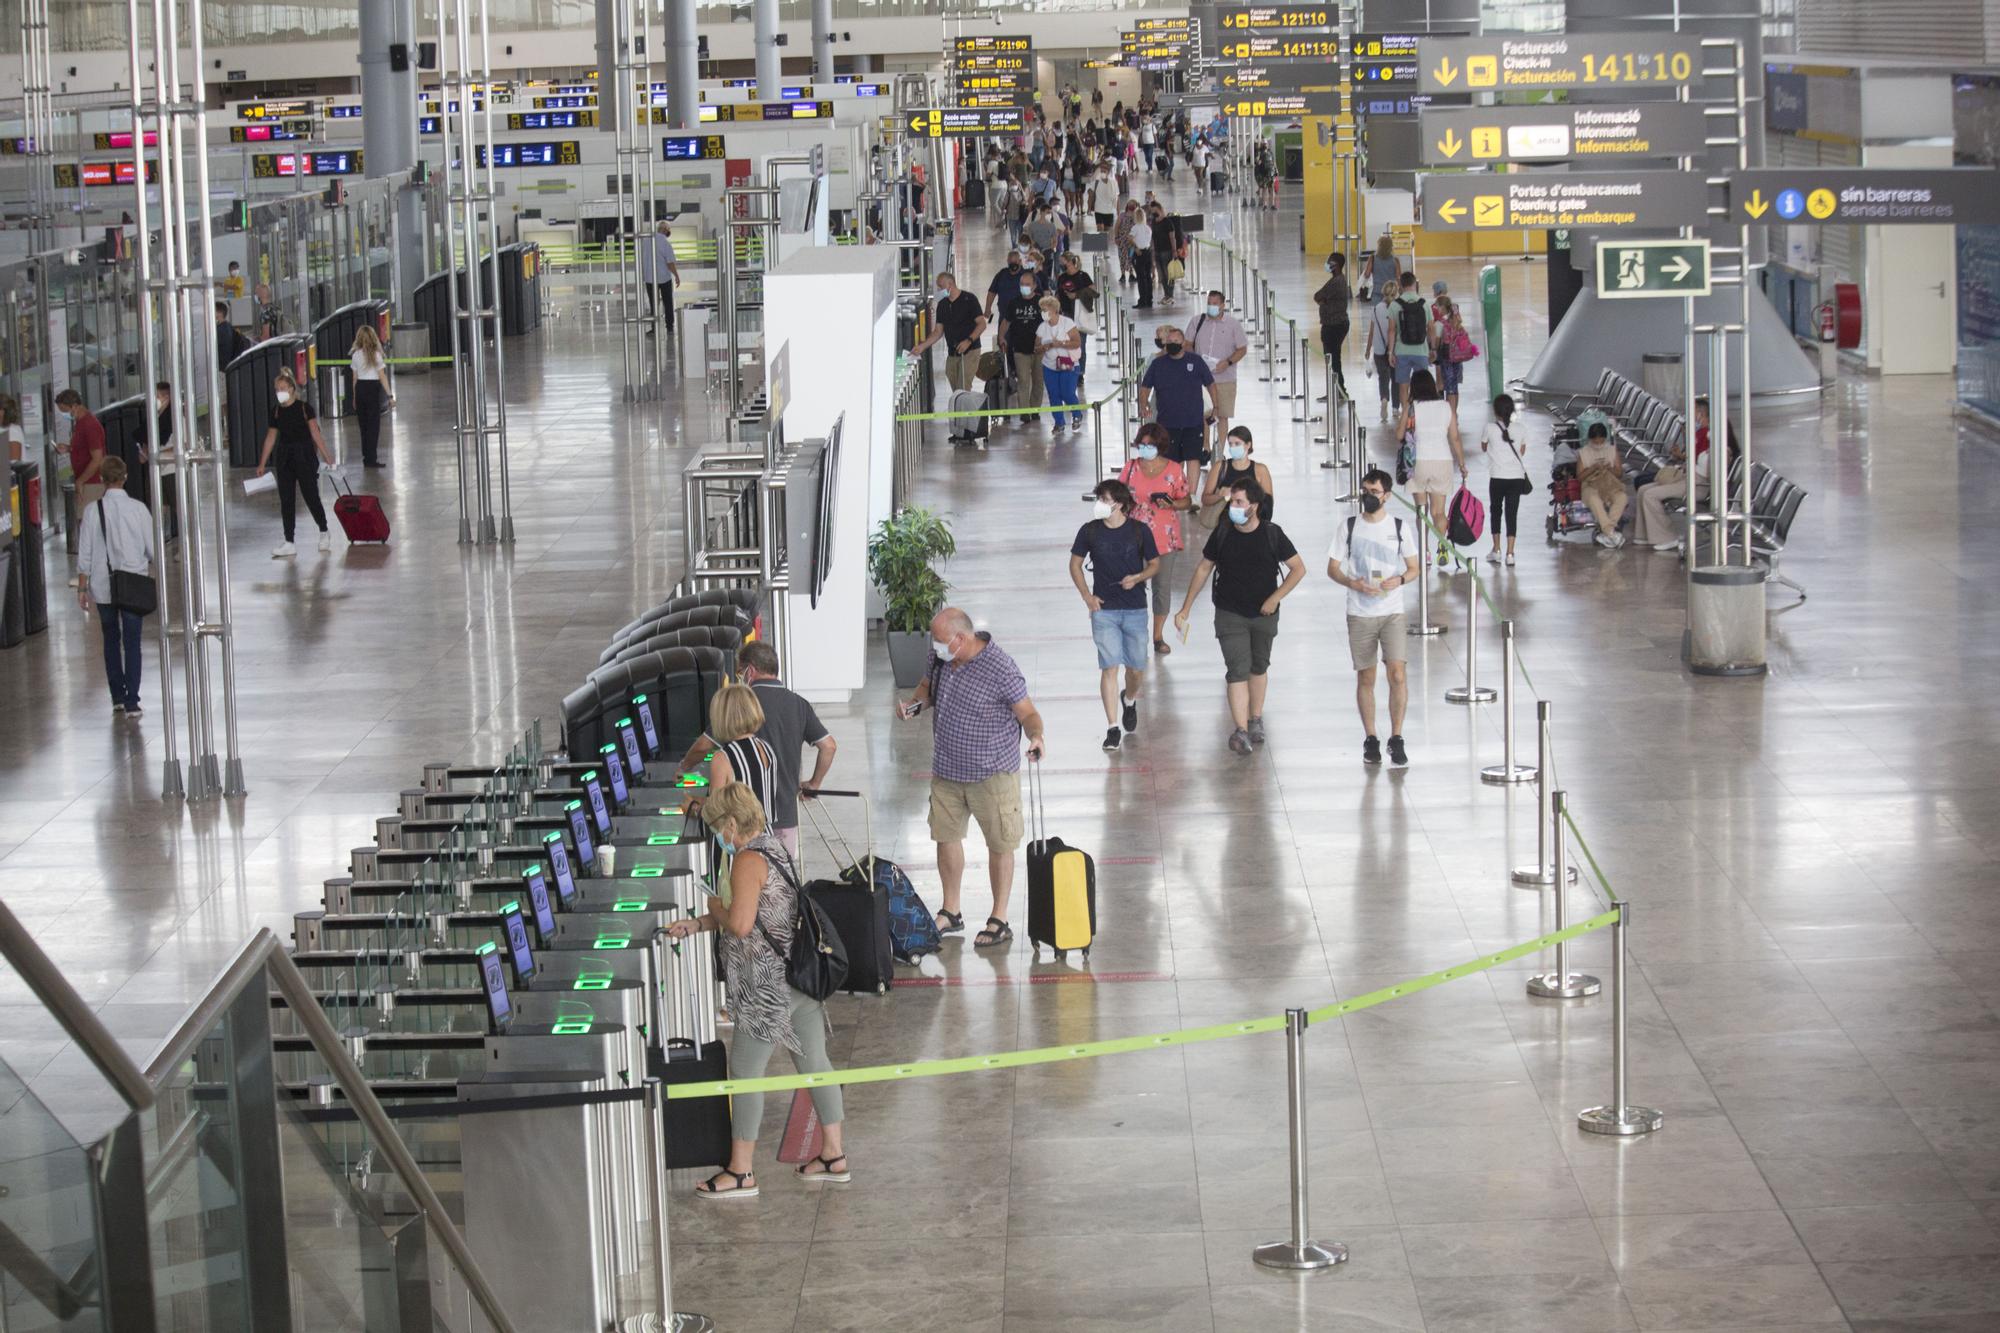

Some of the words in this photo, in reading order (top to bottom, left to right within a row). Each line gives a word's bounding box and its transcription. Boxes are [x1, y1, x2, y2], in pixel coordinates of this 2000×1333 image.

[1282, 12, 1305, 26] 121
[1310, 12, 1327, 26] 10
[995, 41, 1011, 50] 121
[1283, 43, 1307, 56] 141
[1313, 42, 1337, 55] 130
[1502, 40, 1567, 55] Facturació
[1011, 59, 1022, 68] 10
[1503, 56, 1551, 69] Check-in
[1582, 52, 1638, 82] 141
[1654, 51, 1691, 81] 10
[1503, 69, 1577, 84] Facturación
[1574, 110, 1641, 124] Informació
[1575, 125, 1637, 138] Information
[704, 148, 724, 158] 130
[1575, 139, 1650, 154] Información
[560, 154, 577, 164] 131
[255, 166, 274, 177] 134
[1509, 184, 1548, 198] Portes
[1551, 182, 1643, 197] d'embarcament
[1867, 188, 1932, 202] barreras
[1510, 199, 1557, 213] Boarding
[1559, 199, 1587, 212] gates
[1841, 204, 1886, 217] sense
[1889, 203, 1953, 217] barreres
[1511, 212, 1557, 225] Puertas
[1560, 212, 1573, 225] de
[1576, 211, 1636, 226] embarque
